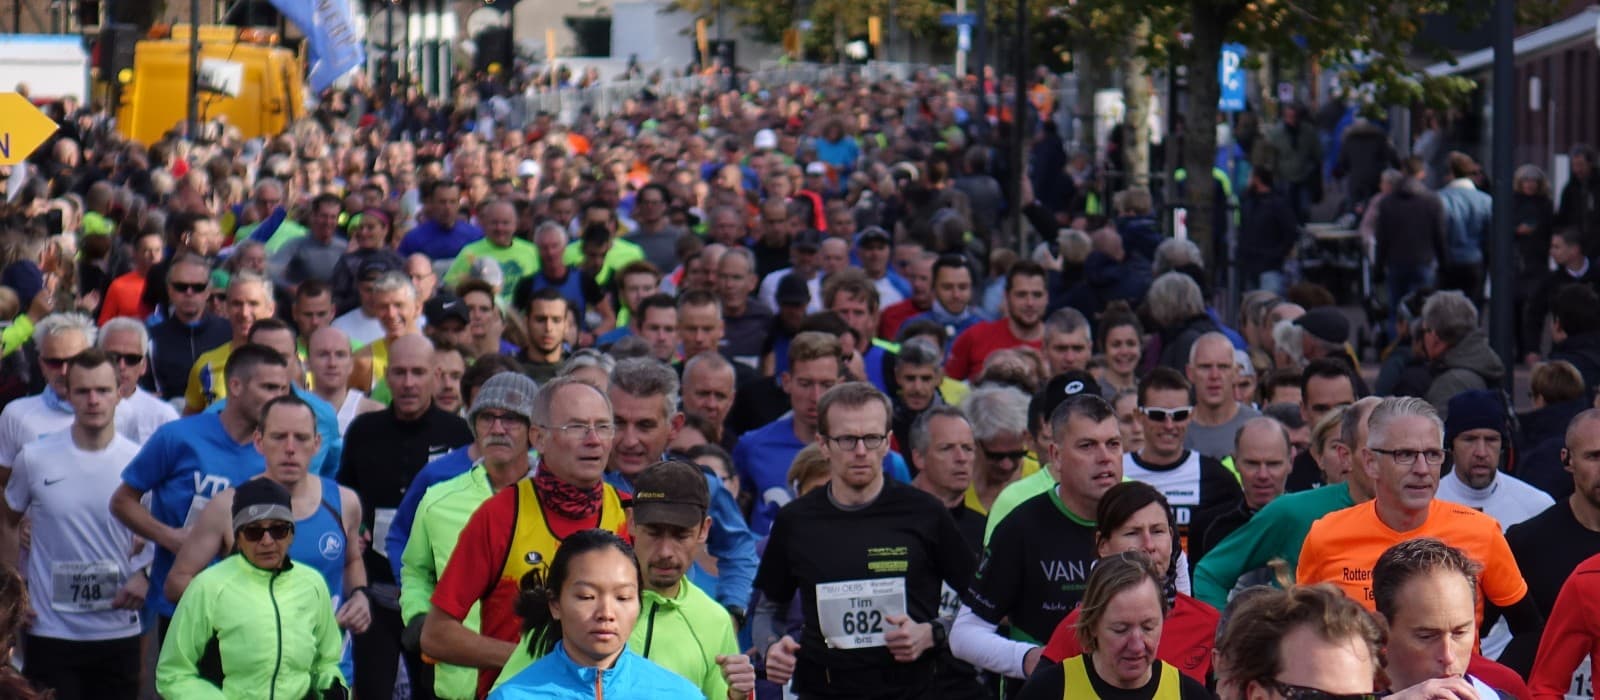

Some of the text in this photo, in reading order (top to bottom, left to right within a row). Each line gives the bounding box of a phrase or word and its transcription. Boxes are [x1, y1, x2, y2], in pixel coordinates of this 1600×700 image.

[1040, 560, 1086, 581] VAN
[70, 584, 102, 603] 748
[848, 597, 873, 608] Tim
[843, 610, 883, 635] 682
